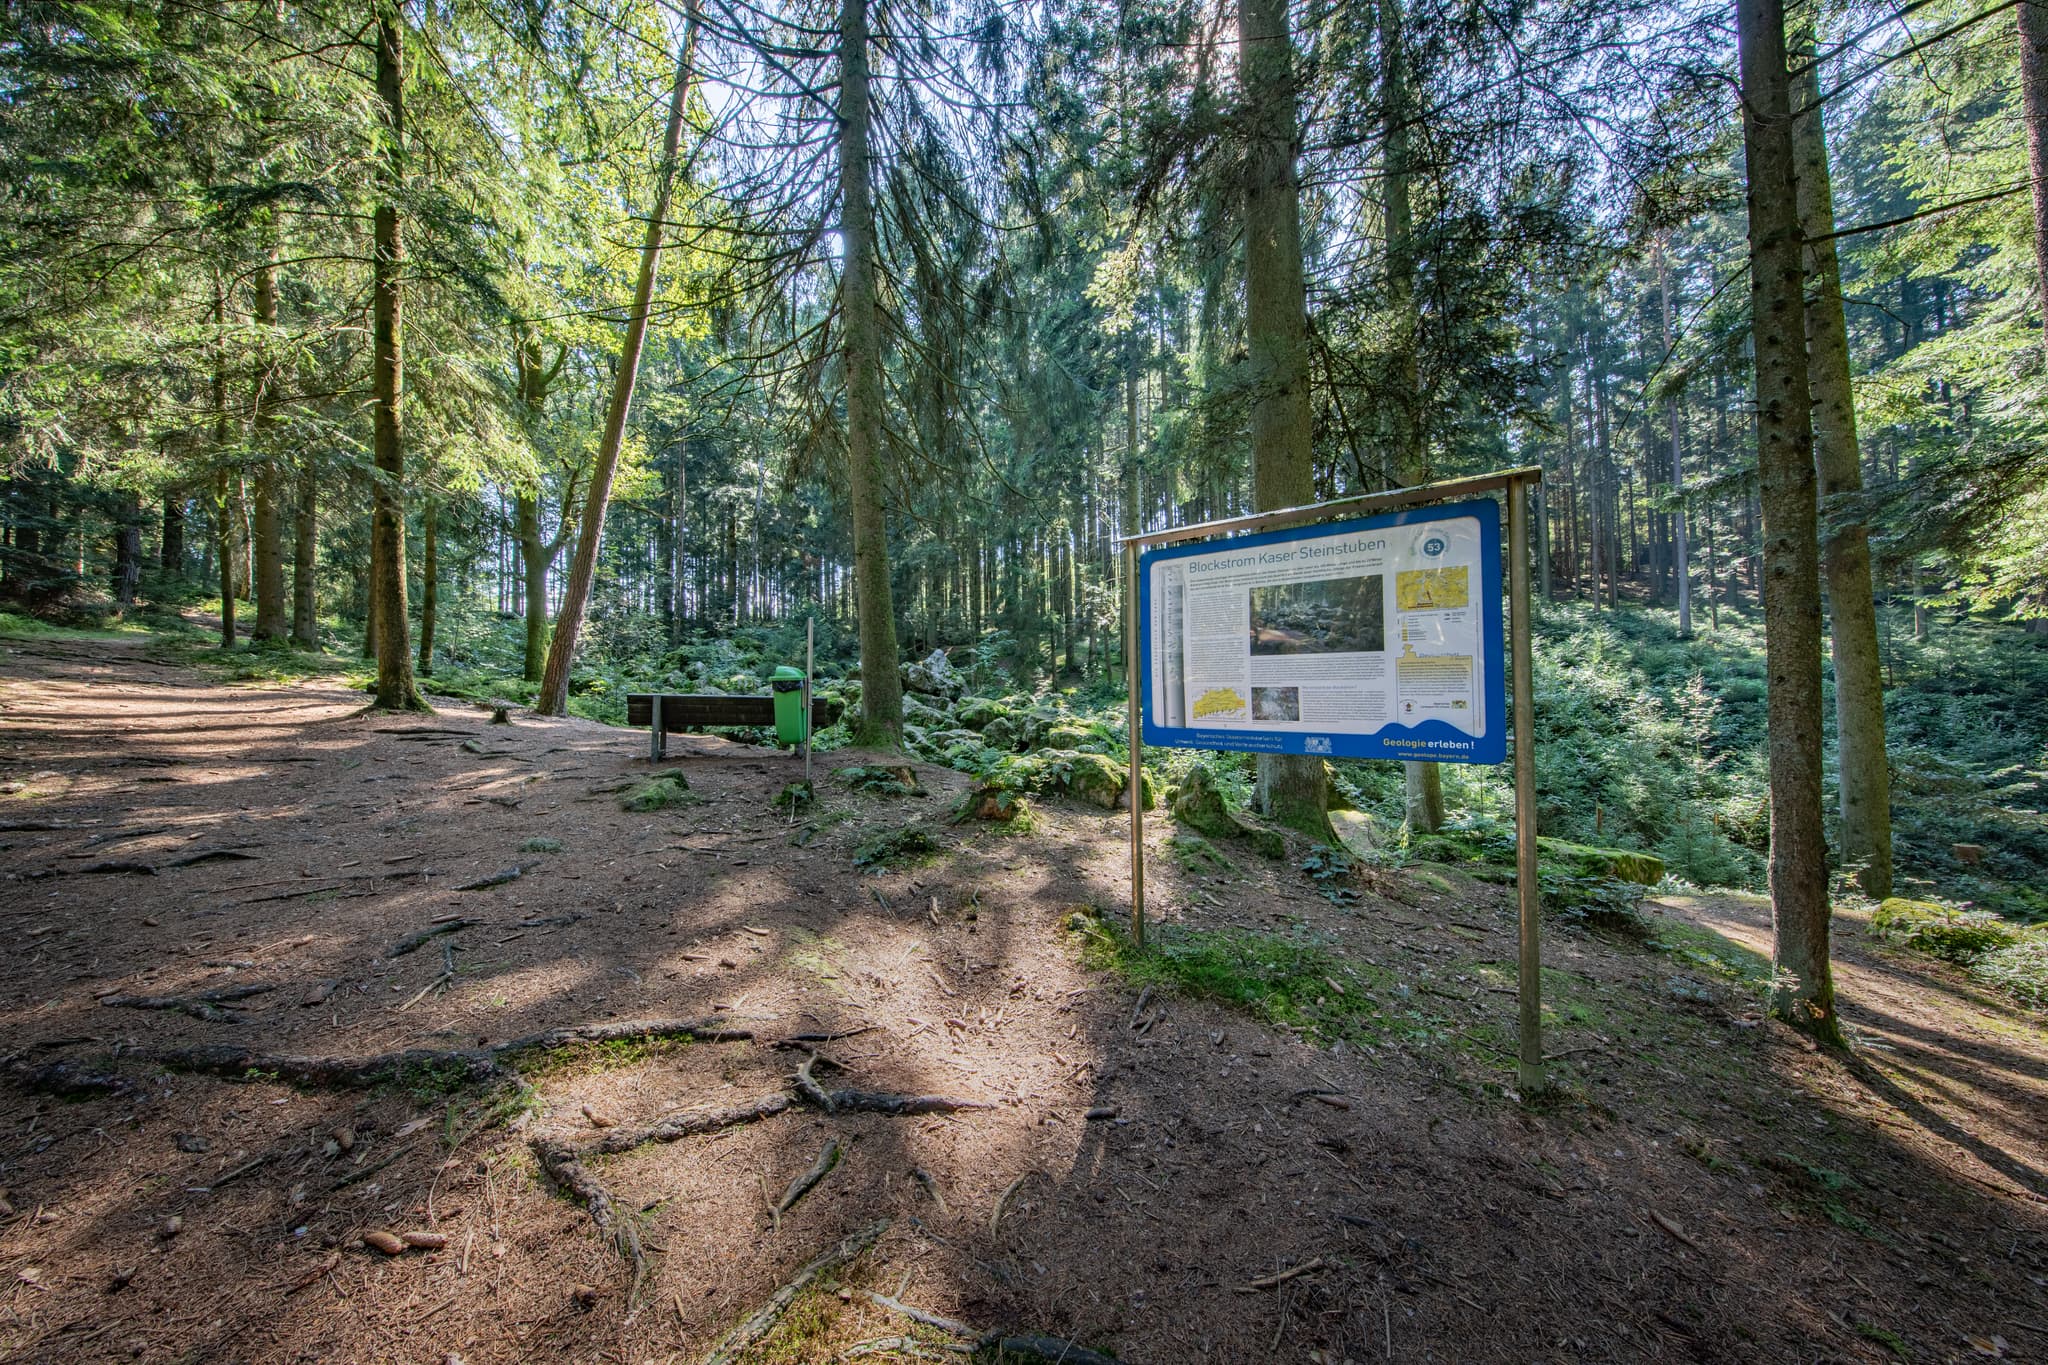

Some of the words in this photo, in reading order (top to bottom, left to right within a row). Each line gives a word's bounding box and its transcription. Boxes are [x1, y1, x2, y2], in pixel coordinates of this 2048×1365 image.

[1427, 542, 1441, 552] 53
[1189, 556, 1256, 574] Blockstrom
[1258, 550, 1297, 565] Kaser
[1299, 538, 1386, 560] Steinstuben
[1383, 738, 1427, 749] Geologie
